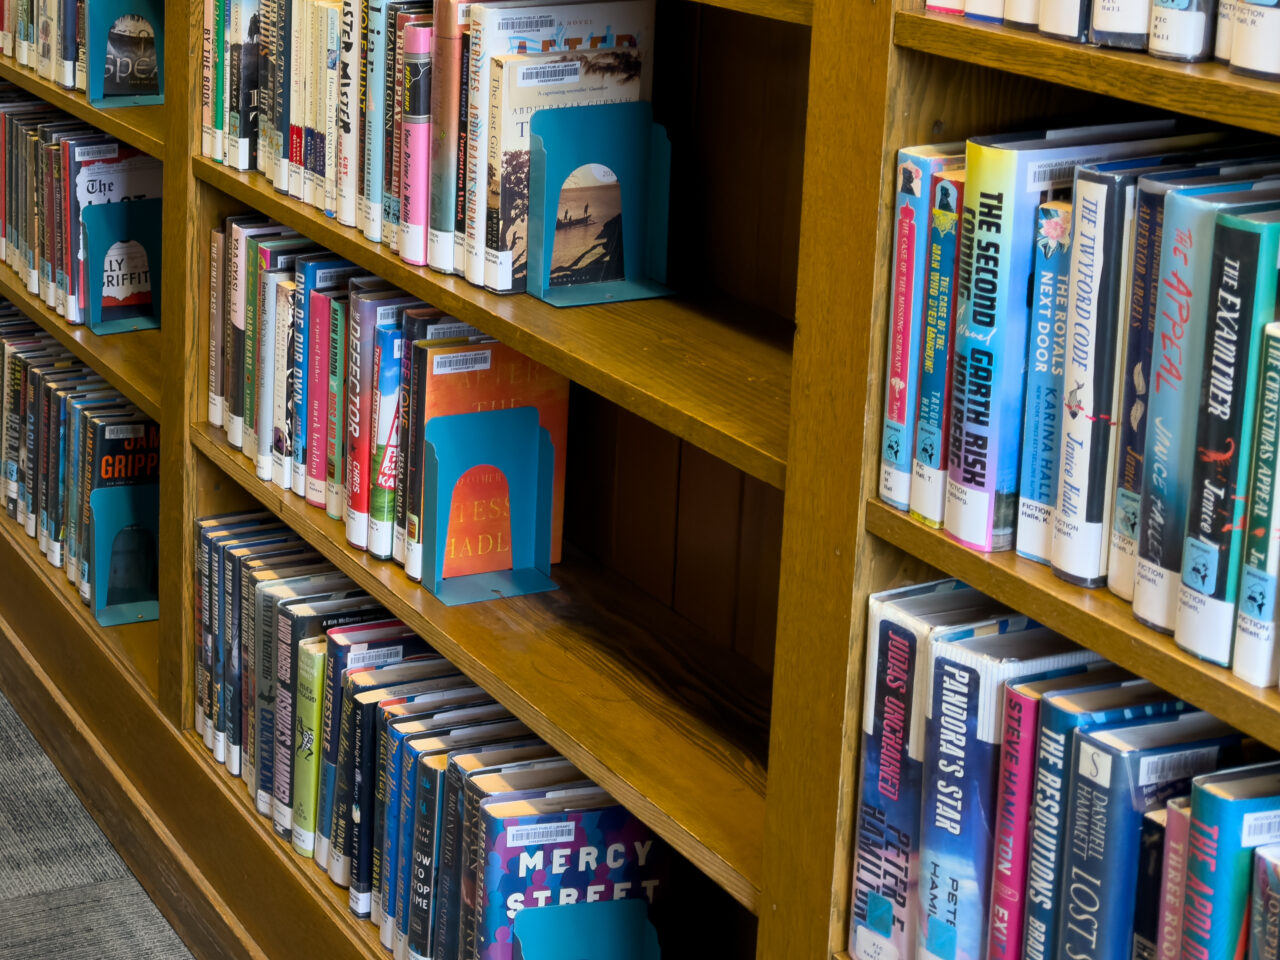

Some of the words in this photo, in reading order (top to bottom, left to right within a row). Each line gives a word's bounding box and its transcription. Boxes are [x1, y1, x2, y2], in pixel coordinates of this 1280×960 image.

[387, 10, 395, 87] ELIZABETH
[470, 19, 482, 92] AFTERLIVES
[339, 60, 353, 134] MISTER
[385, 92, 394, 131] GUNN
[492, 77, 500, 100] The
[468, 103, 480, 184] ABDULRAZAK
[490, 105, 500, 132] Last
[490, 135, 499, 160] Gift
[86, 178, 114, 196] The
[979, 191, 1004, 235] THE
[1081, 196, 1098, 226] THE
[467, 187, 478, 241] GURNAH
[1173, 228, 1193, 266] THE
[1223, 256, 1240, 289] THE
[295, 272, 305, 305] ONE
[971, 238, 1001, 329] SECOND
[1038, 271, 1054, 318] NEXT
[1057, 275, 1069, 301] THE
[1076, 229, 1097, 319] TWYFORD
[295, 307, 304, 328] OF
[1051, 305, 1066, 376] ROYALS
[1155, 269, 1193, 394] APPEAL
[294, 329, 303, 363] OUR
[330, 338, 338, 377] HADDON
[1035, 322, 1052, 372] DOOR
[1072, 322, 1091, 371] CODE
[1208, 287, 1241, 422] EXAMINER
[293, 368, 303, 404] OWN
[348, 322, 362, 438] DEFECTOR
[965, 347, 993, 429] GARTH
[86, 425, 94, 462] JAMES
[962, 432, 988, 489] RISK
[83, 465, 91, 525] GRIPPANDO
[352, 461, 360, 493] CHRIS
[1022, 501, 1051, 516] FICTION
[886, 630, 910, 693] JUDAS
[323, 680, 333, 753] LIFESTYLE
[938, 664, 970, 778] PANDORA'S
[1005, 698, 1023, 766] STEVE
[878, 695, 906, 802] UNCHAINED
[1040, 726, 1066, 770] THE
[935, 779, 962, 836] STAR
[998, 771, 1018, 876] HAMILTON
[1072, 782, 1093, 860] HAMMETT
[1088, 790, 1108, 860] DASHIELL
[519, 840, 653, 878] MERCY
[1029, 767, 1062, 910] RESOLUTIONS
[477, 869, 485, 922] STREET
[507, 879, 659, 919] STREET
[1067, 866, 1101, 949] LOST
[991, 903, 1009, 953] EXIT
